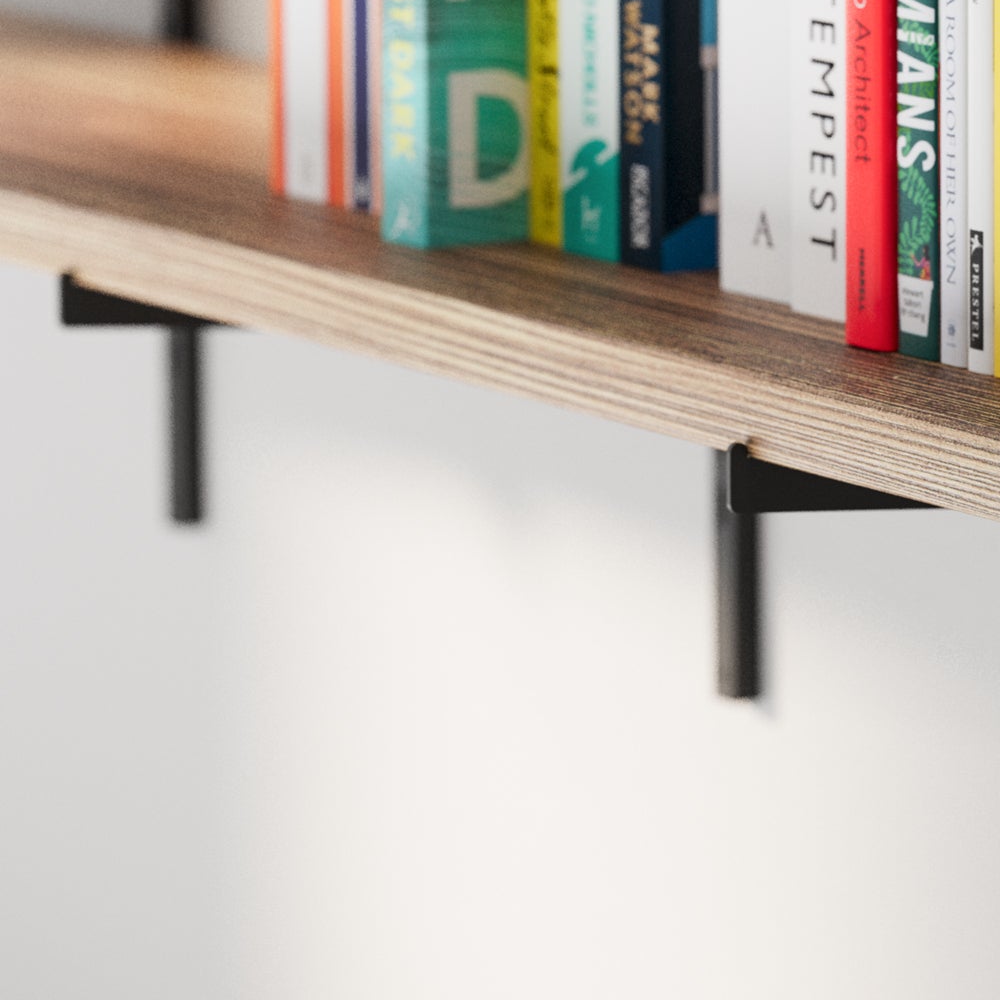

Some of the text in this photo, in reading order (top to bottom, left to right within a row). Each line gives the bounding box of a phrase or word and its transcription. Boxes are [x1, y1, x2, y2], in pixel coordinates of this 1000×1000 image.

[389, 39, 415, 161] DARK
[623, 0, 643, 146] WATSON
[641, 24, 660, 125] MARK
[854, 19, 871, 164] Architect
[945, 15, 956, 102] ROOM
[945, 109, 956, 146] OF
[945, 152, 956, 207] HER
[946, 217, 957, 285] OWN
[971, 263, 980, 342] PRESTEL
